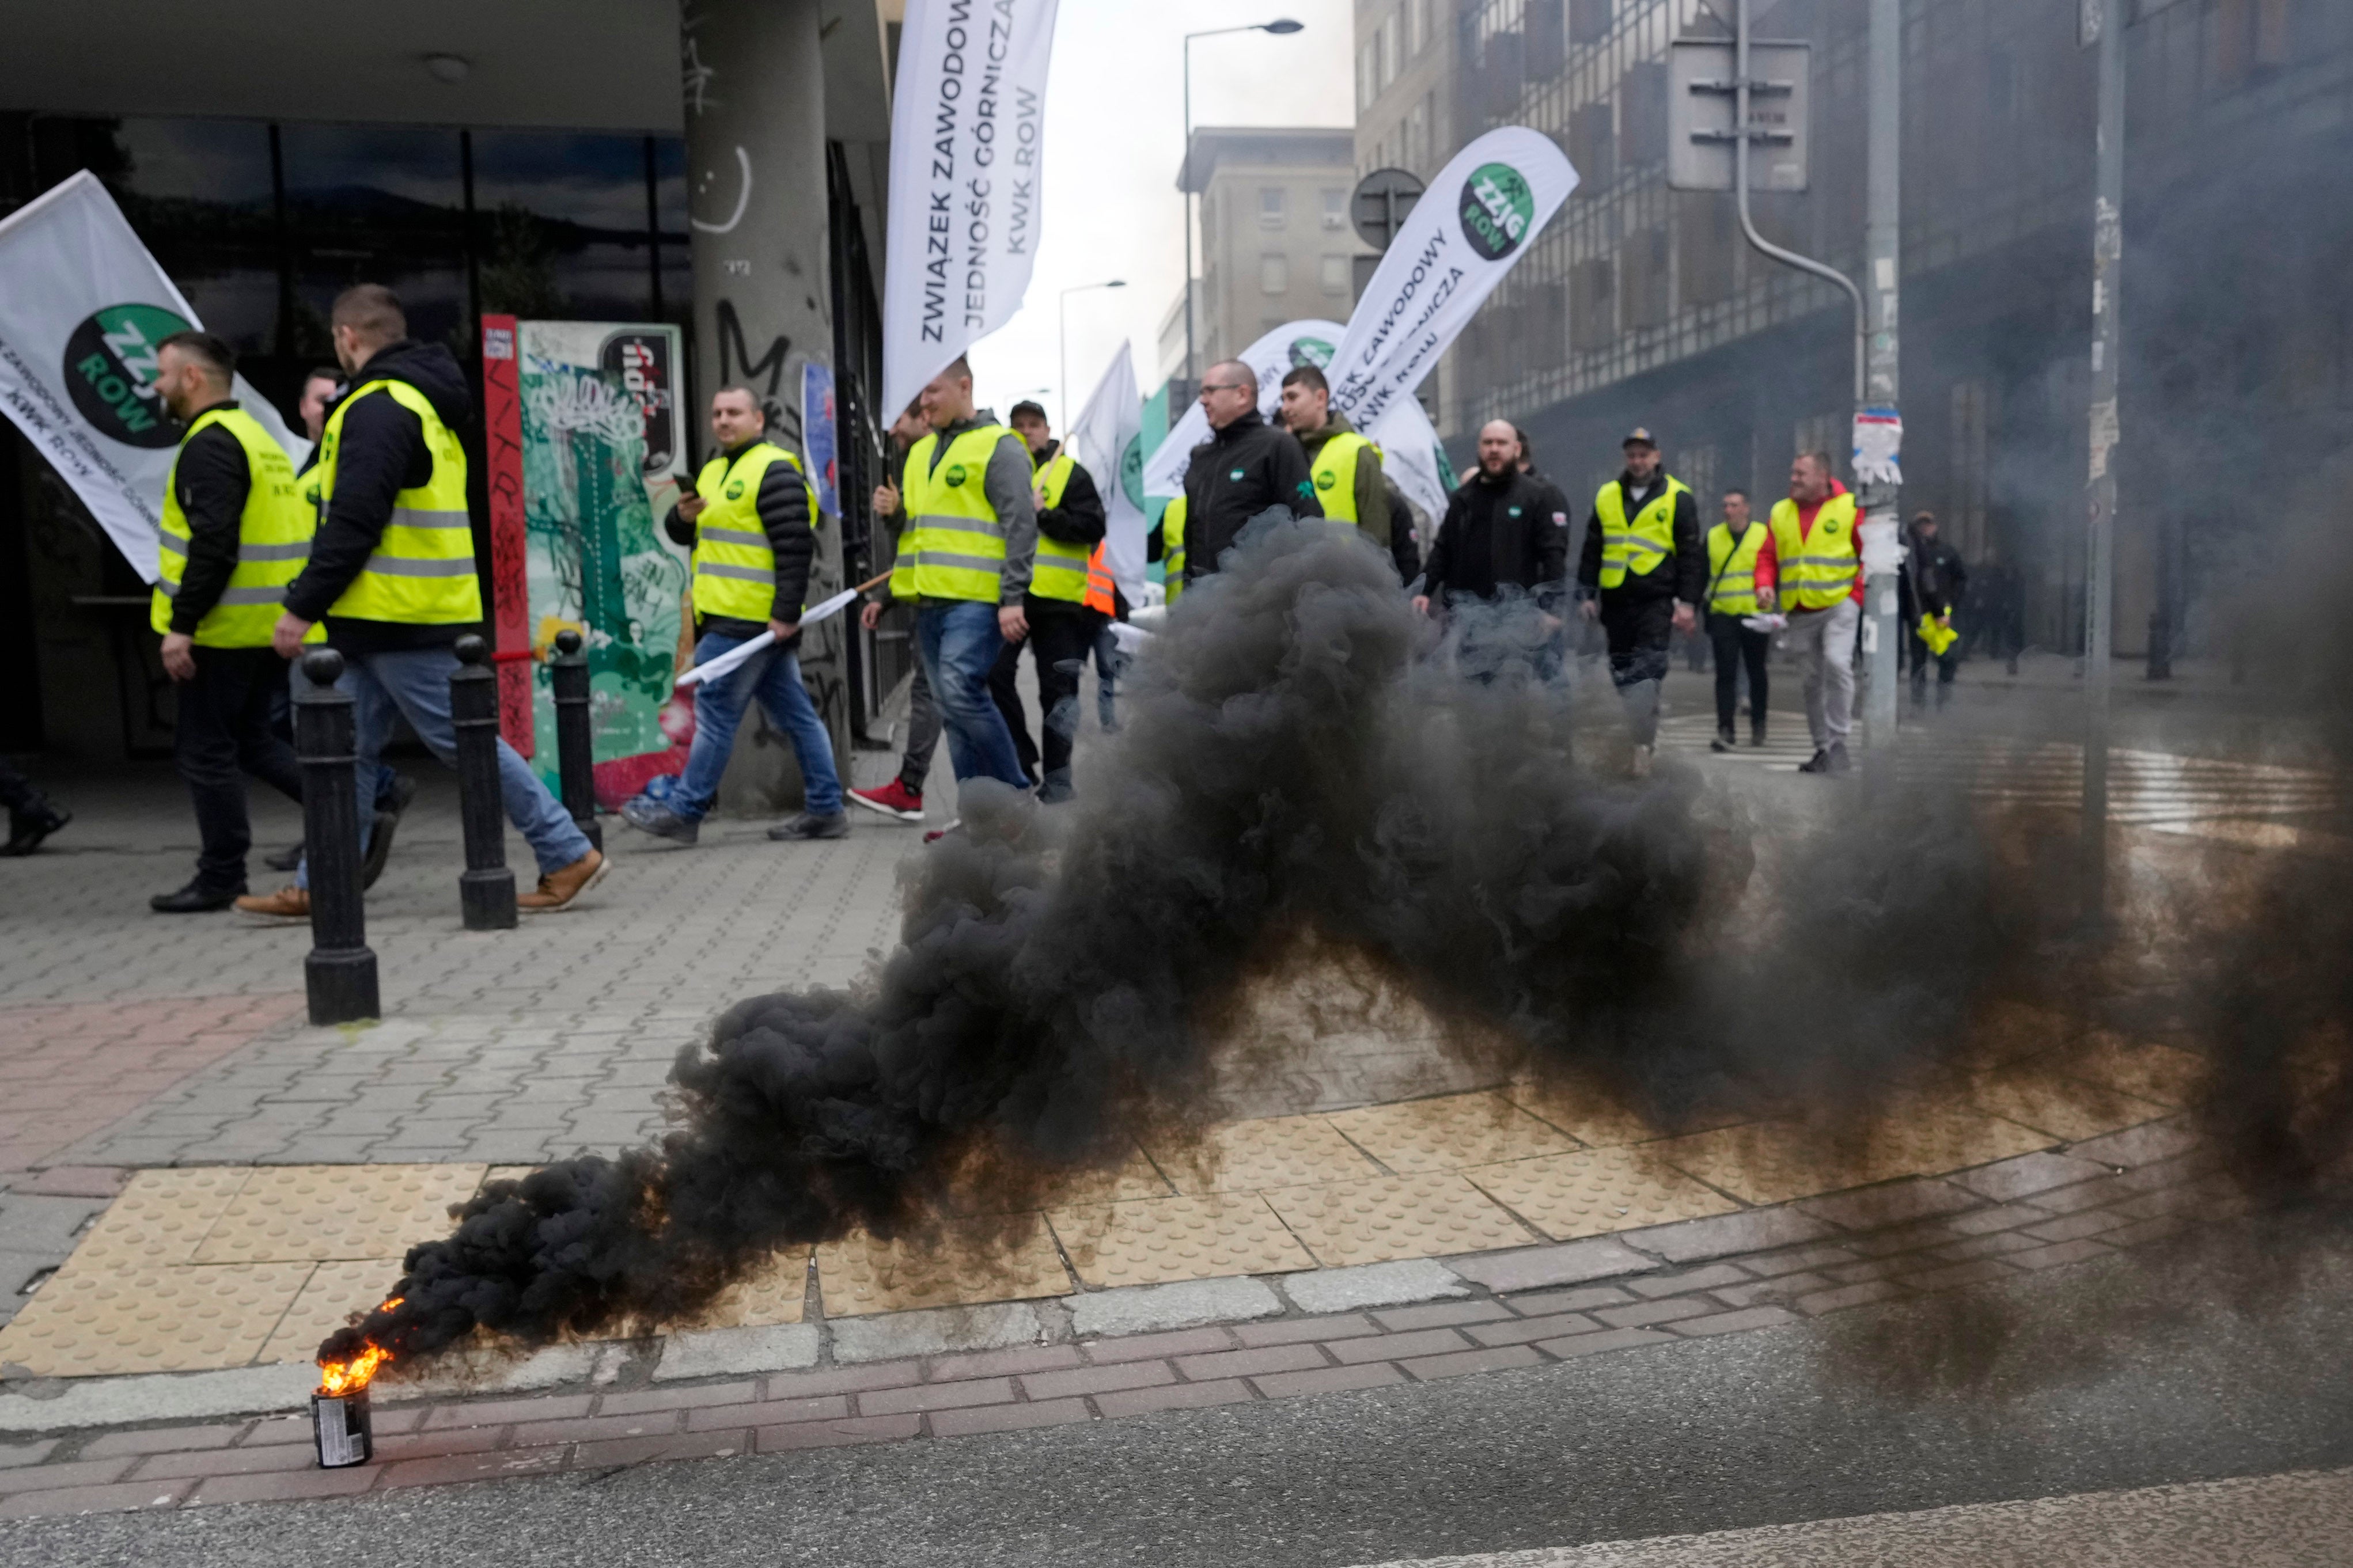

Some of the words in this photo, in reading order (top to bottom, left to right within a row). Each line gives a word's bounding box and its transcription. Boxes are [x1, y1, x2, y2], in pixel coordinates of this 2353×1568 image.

[932, 0, 971, 180] ZAWODOW
[970, 0, 1013, 167] GÓRNICZA
[1014, 86, 1037, 167] ROW
[1007, 179, 1032, 254] KWK
[1464, 203, 1506, 252] ROW
[1473, 176, 1525, 239] ZZJG
[922, 192, 952, 343] ZWIĄZEK
[965, 179, 991, 328] JEDNOŚĆ
[77, 352, 158, 434] ROW
[102, 320, 162, 402] ZZJ
[6, 389, 51, 433] KWK
[1354, 386, 1396, 433] KWK
